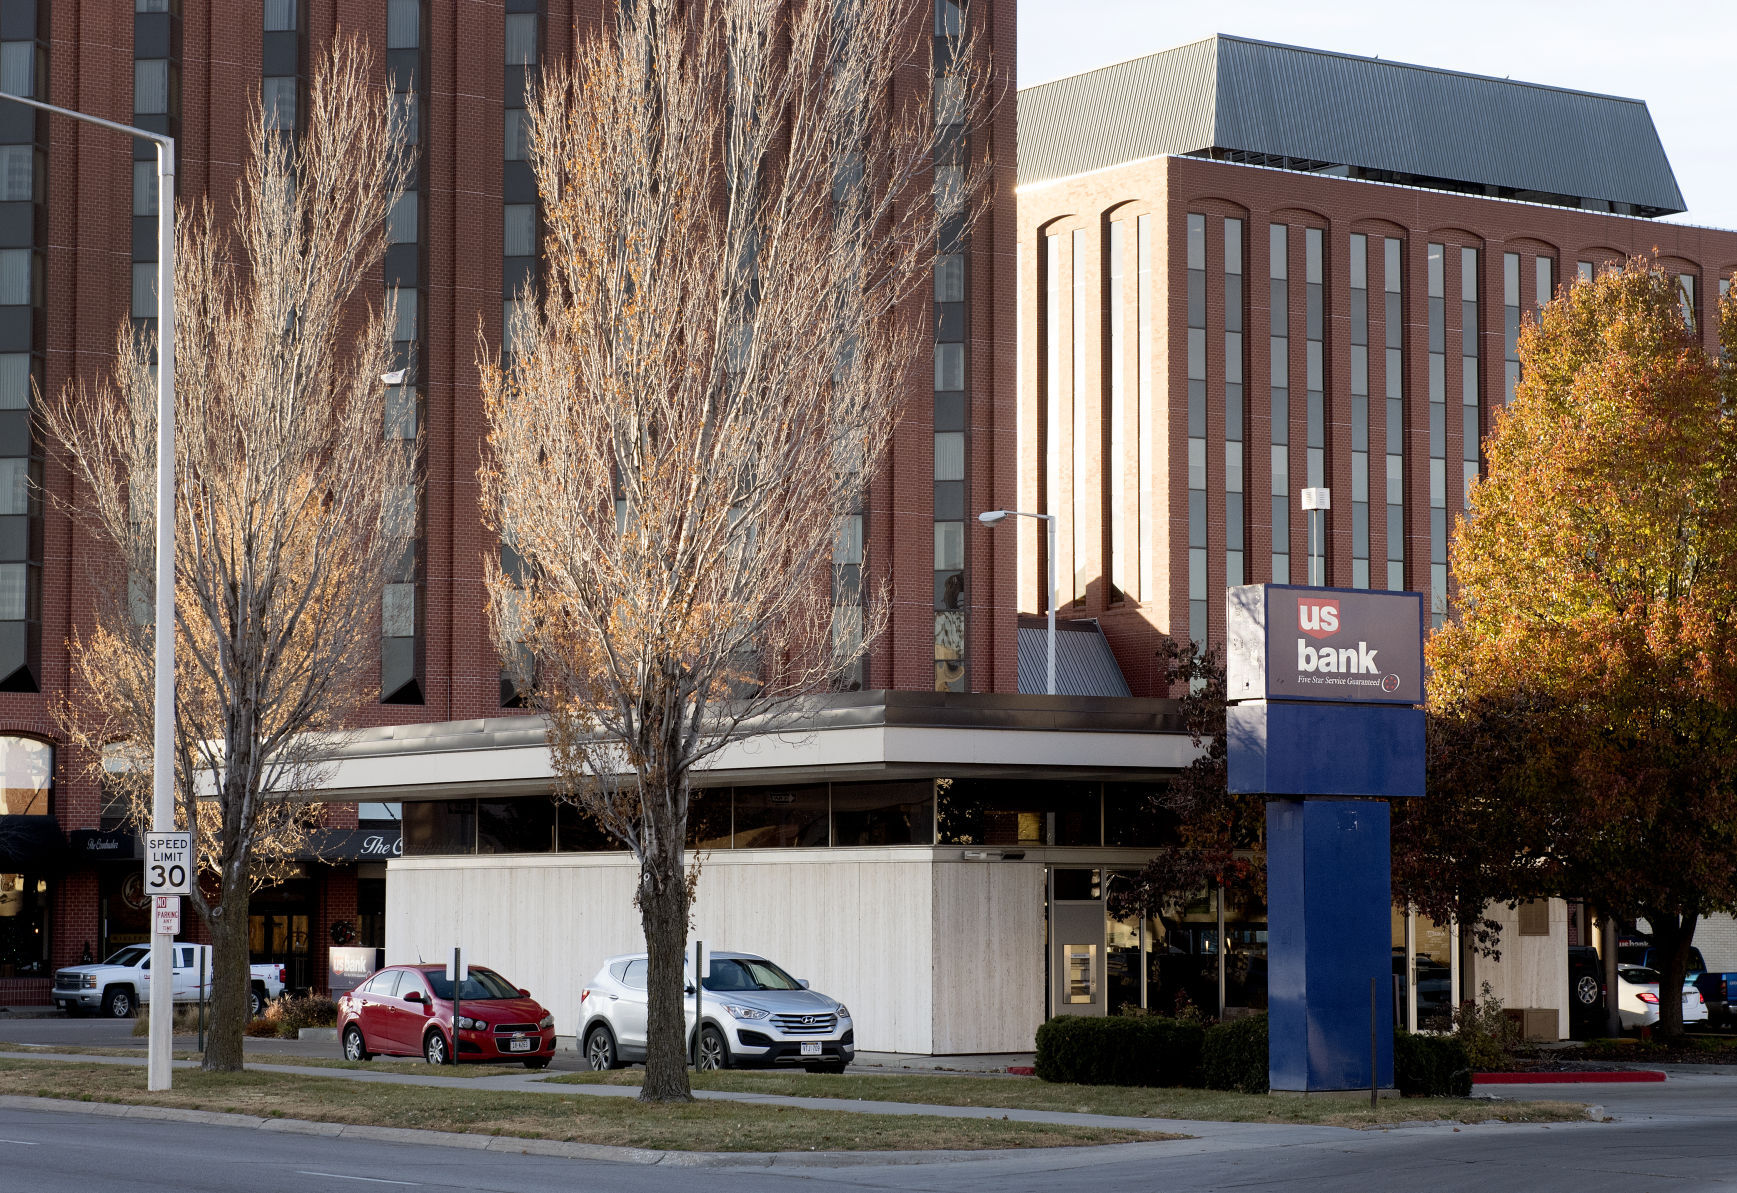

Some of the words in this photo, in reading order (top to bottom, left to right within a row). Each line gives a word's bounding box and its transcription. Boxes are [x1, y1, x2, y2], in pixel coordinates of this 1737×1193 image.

[1299, 605, 1339, 632] us
[1298, 639, 1379, 674] bank
[1297, 675, 1311, 683] Five
[1312, 676, 1324, 684] Star
[1325, 676, 1346, 685] Service
[1347, 677, 1380, 686] Guaranteed
[149, 839, 188, 849] SPEED
[360, 835, 391, 854] The
[153, 852, 183, 861] LIMIT
[150, 865, 186, 887] 30
[157, 897, 166, 908] NO
